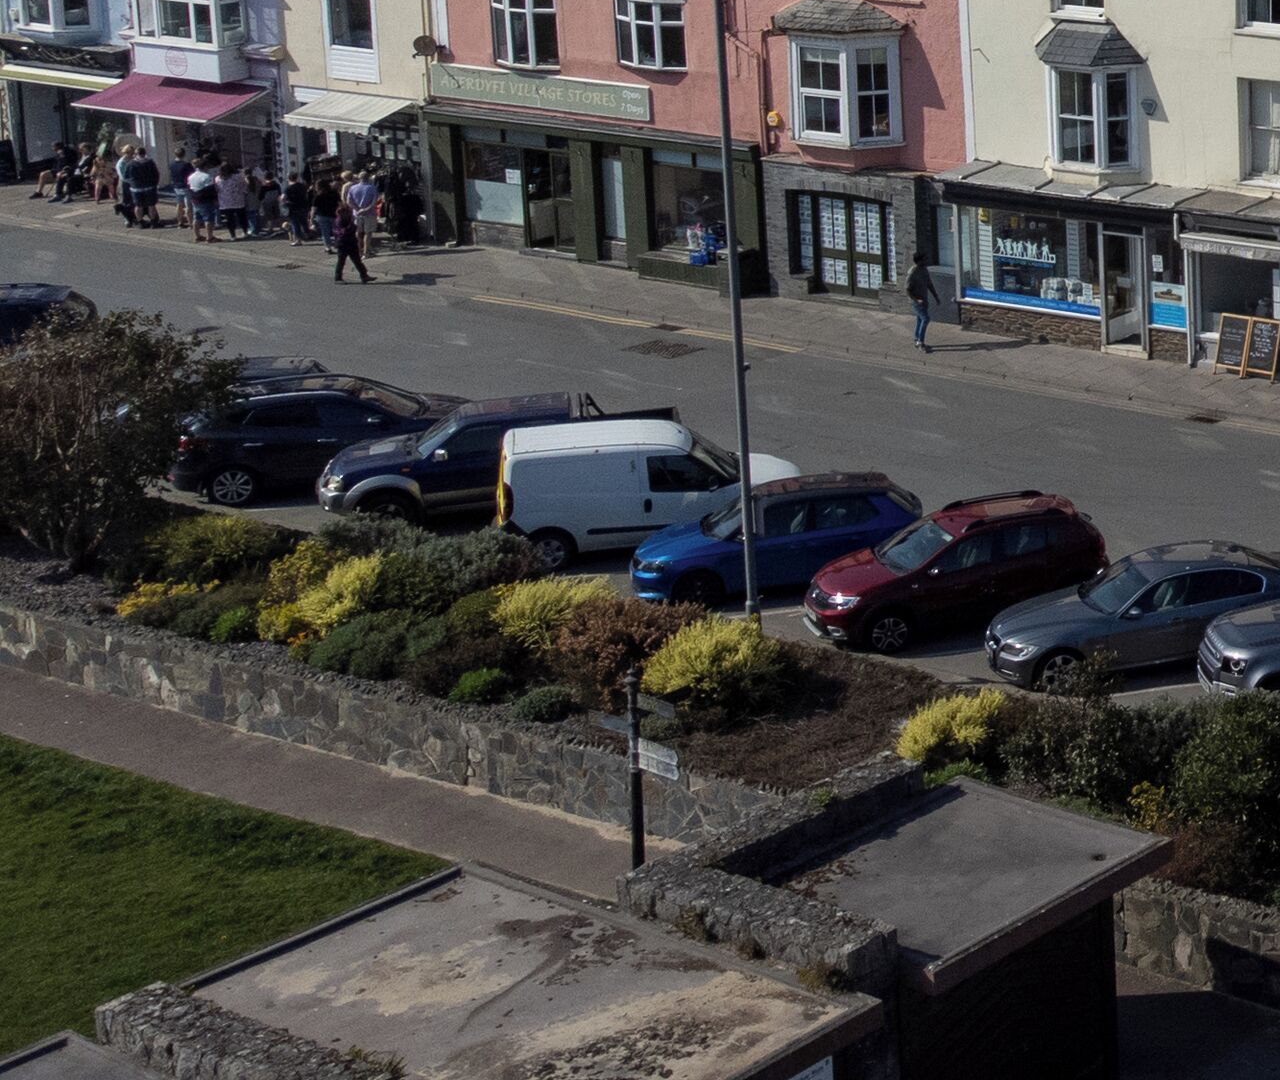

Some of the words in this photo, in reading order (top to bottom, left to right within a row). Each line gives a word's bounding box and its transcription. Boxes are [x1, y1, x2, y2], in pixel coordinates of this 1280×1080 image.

[440, 75, 505, 94] ABERDYFI
[509, 82, 564, 100] VILLAGE
[567, 89, 617, 107] STORES
